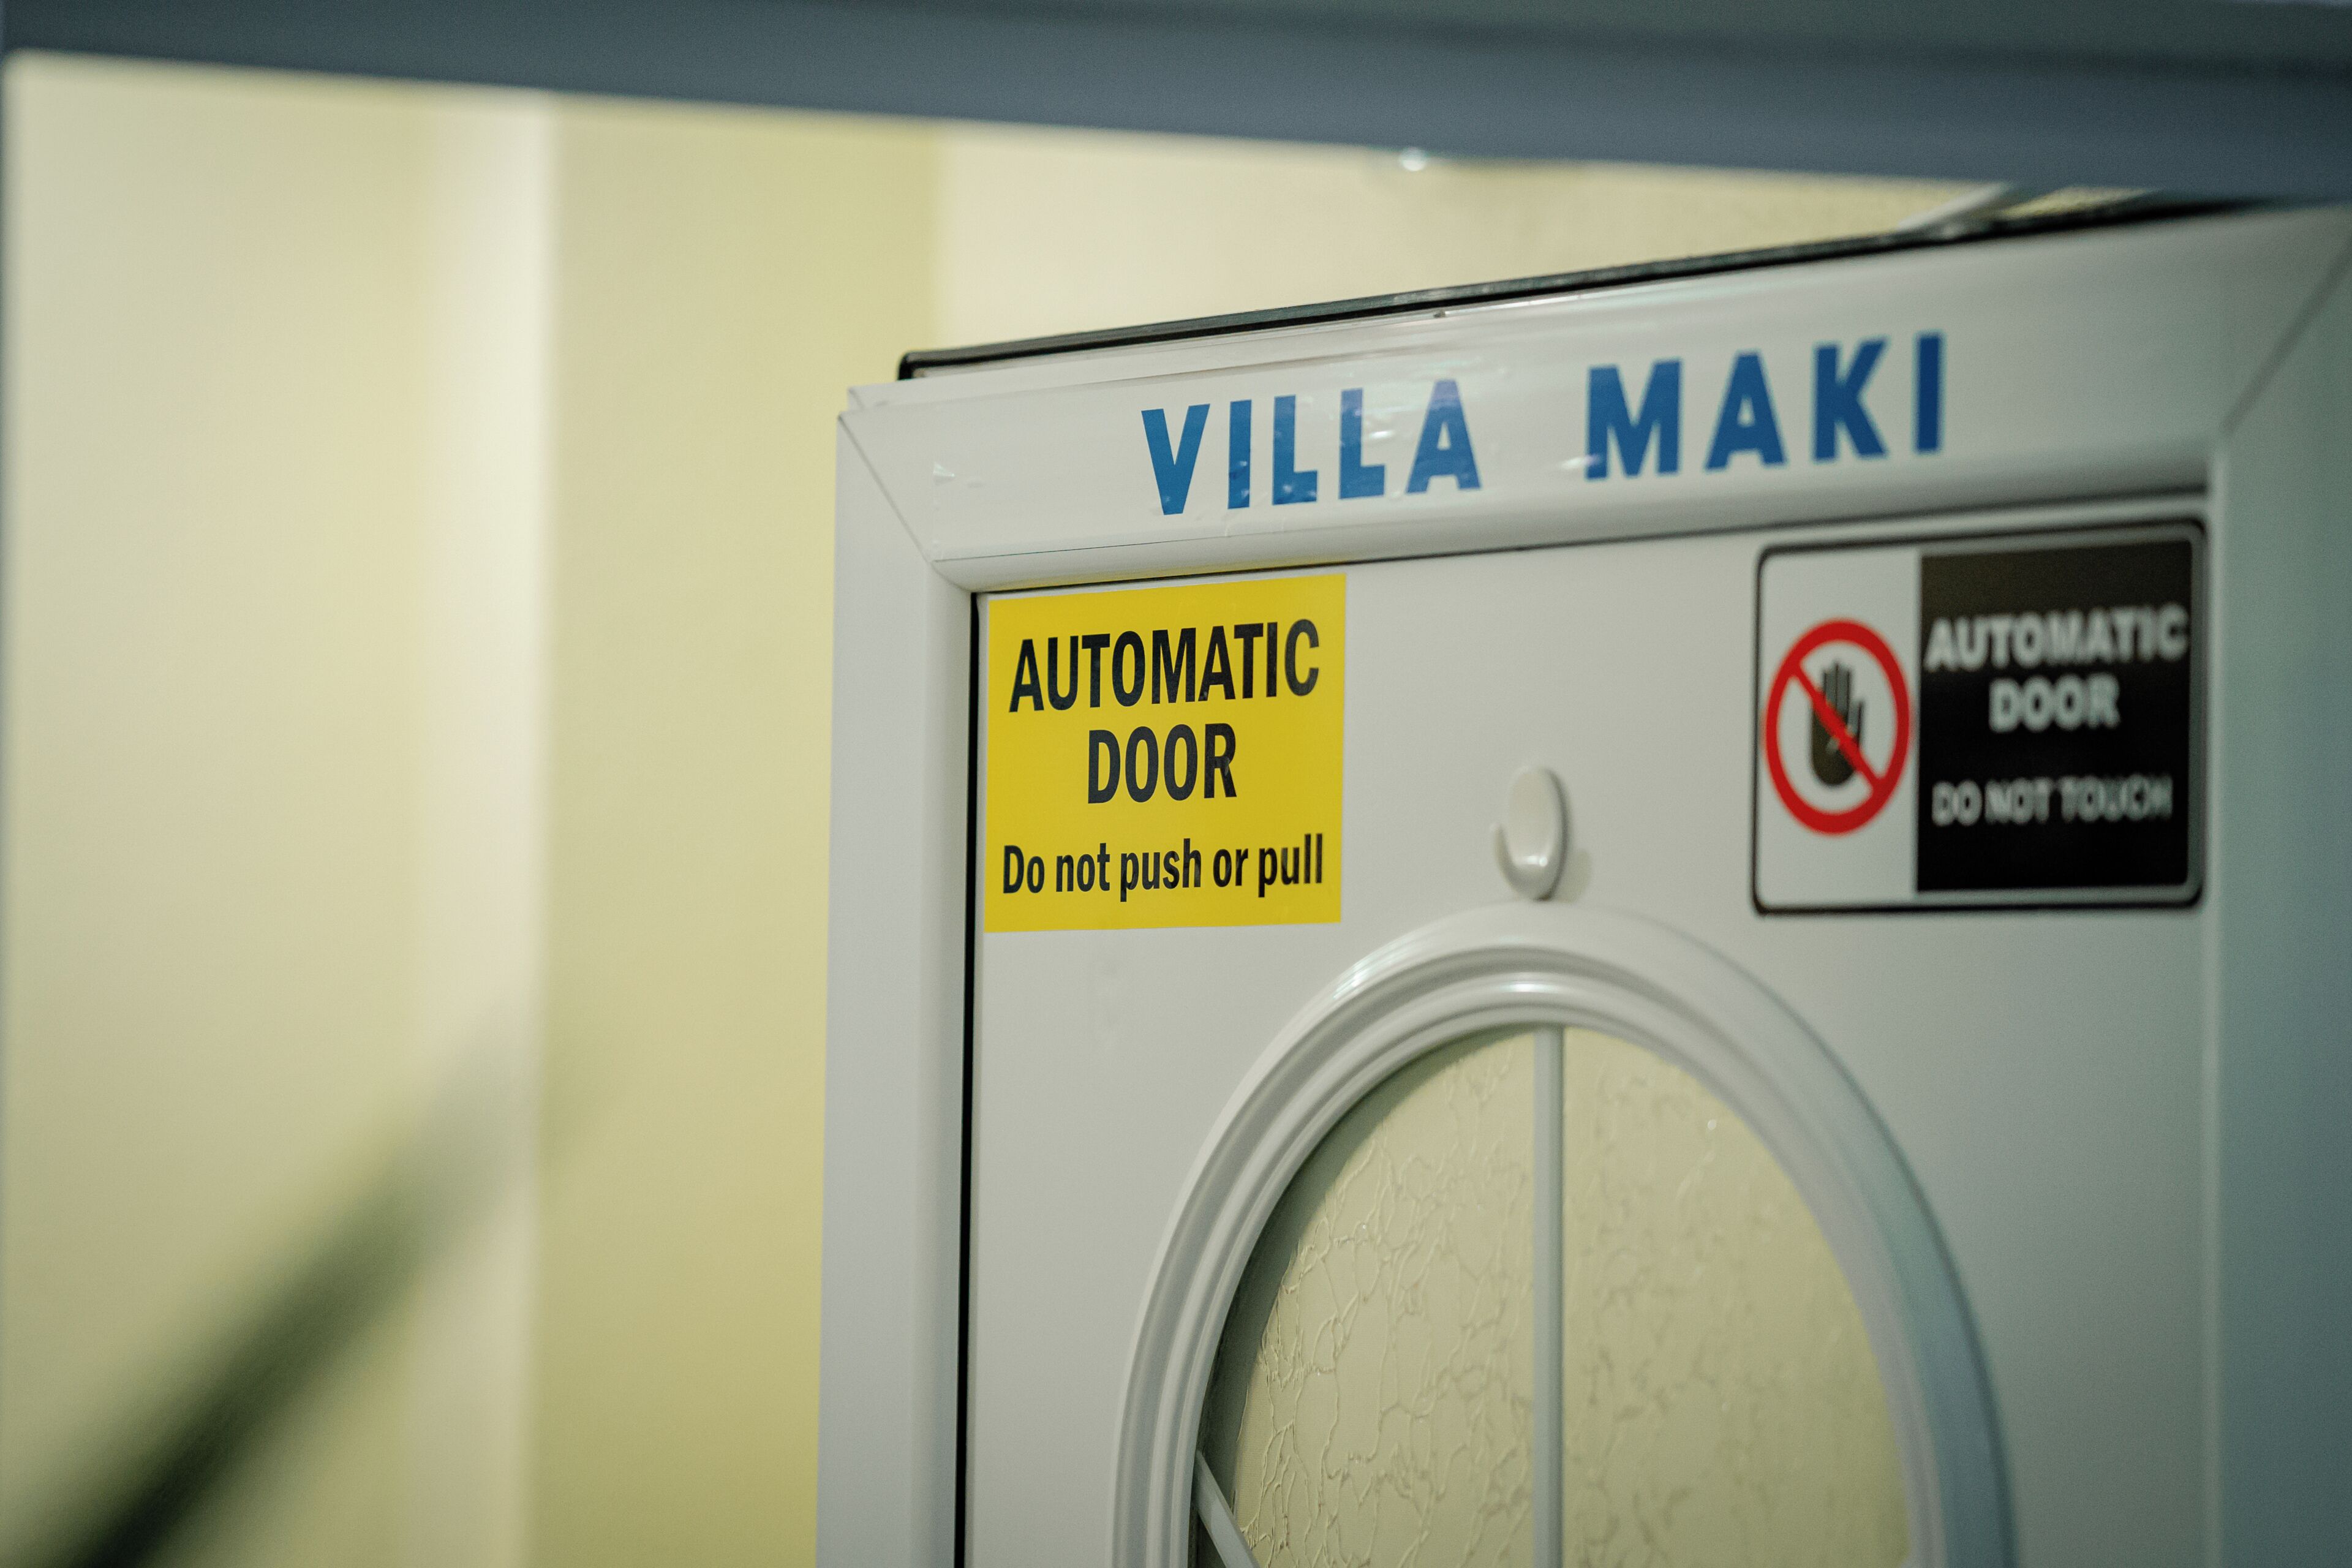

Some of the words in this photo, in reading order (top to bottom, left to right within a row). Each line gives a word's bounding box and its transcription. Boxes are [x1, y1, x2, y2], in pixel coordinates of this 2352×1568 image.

[1141, 379, 1481, 515] VILLA
[1585, 331, 1943, 482] MAKI
[1009, 619, 1320, 712] AUTOMATIC
[1924, 604, 2188, 671] AUTOMATIC
[1989, 673, 2120, 733] DOOR
[1088, 723, 1237, 804] DOOR
[1932, 780, 1982, 827] DO
[1985, 778, 2049, 825] NOT
[2059, 774, 2173, 823] TOUCH
[1003, 844, 1045, 894] Do
[1056, 843, 1110, 892] not
[1120, 838, 1201, 902] push
[1213, 848, 1248, 887] or
[1258, 833, 1323, 897] pull
